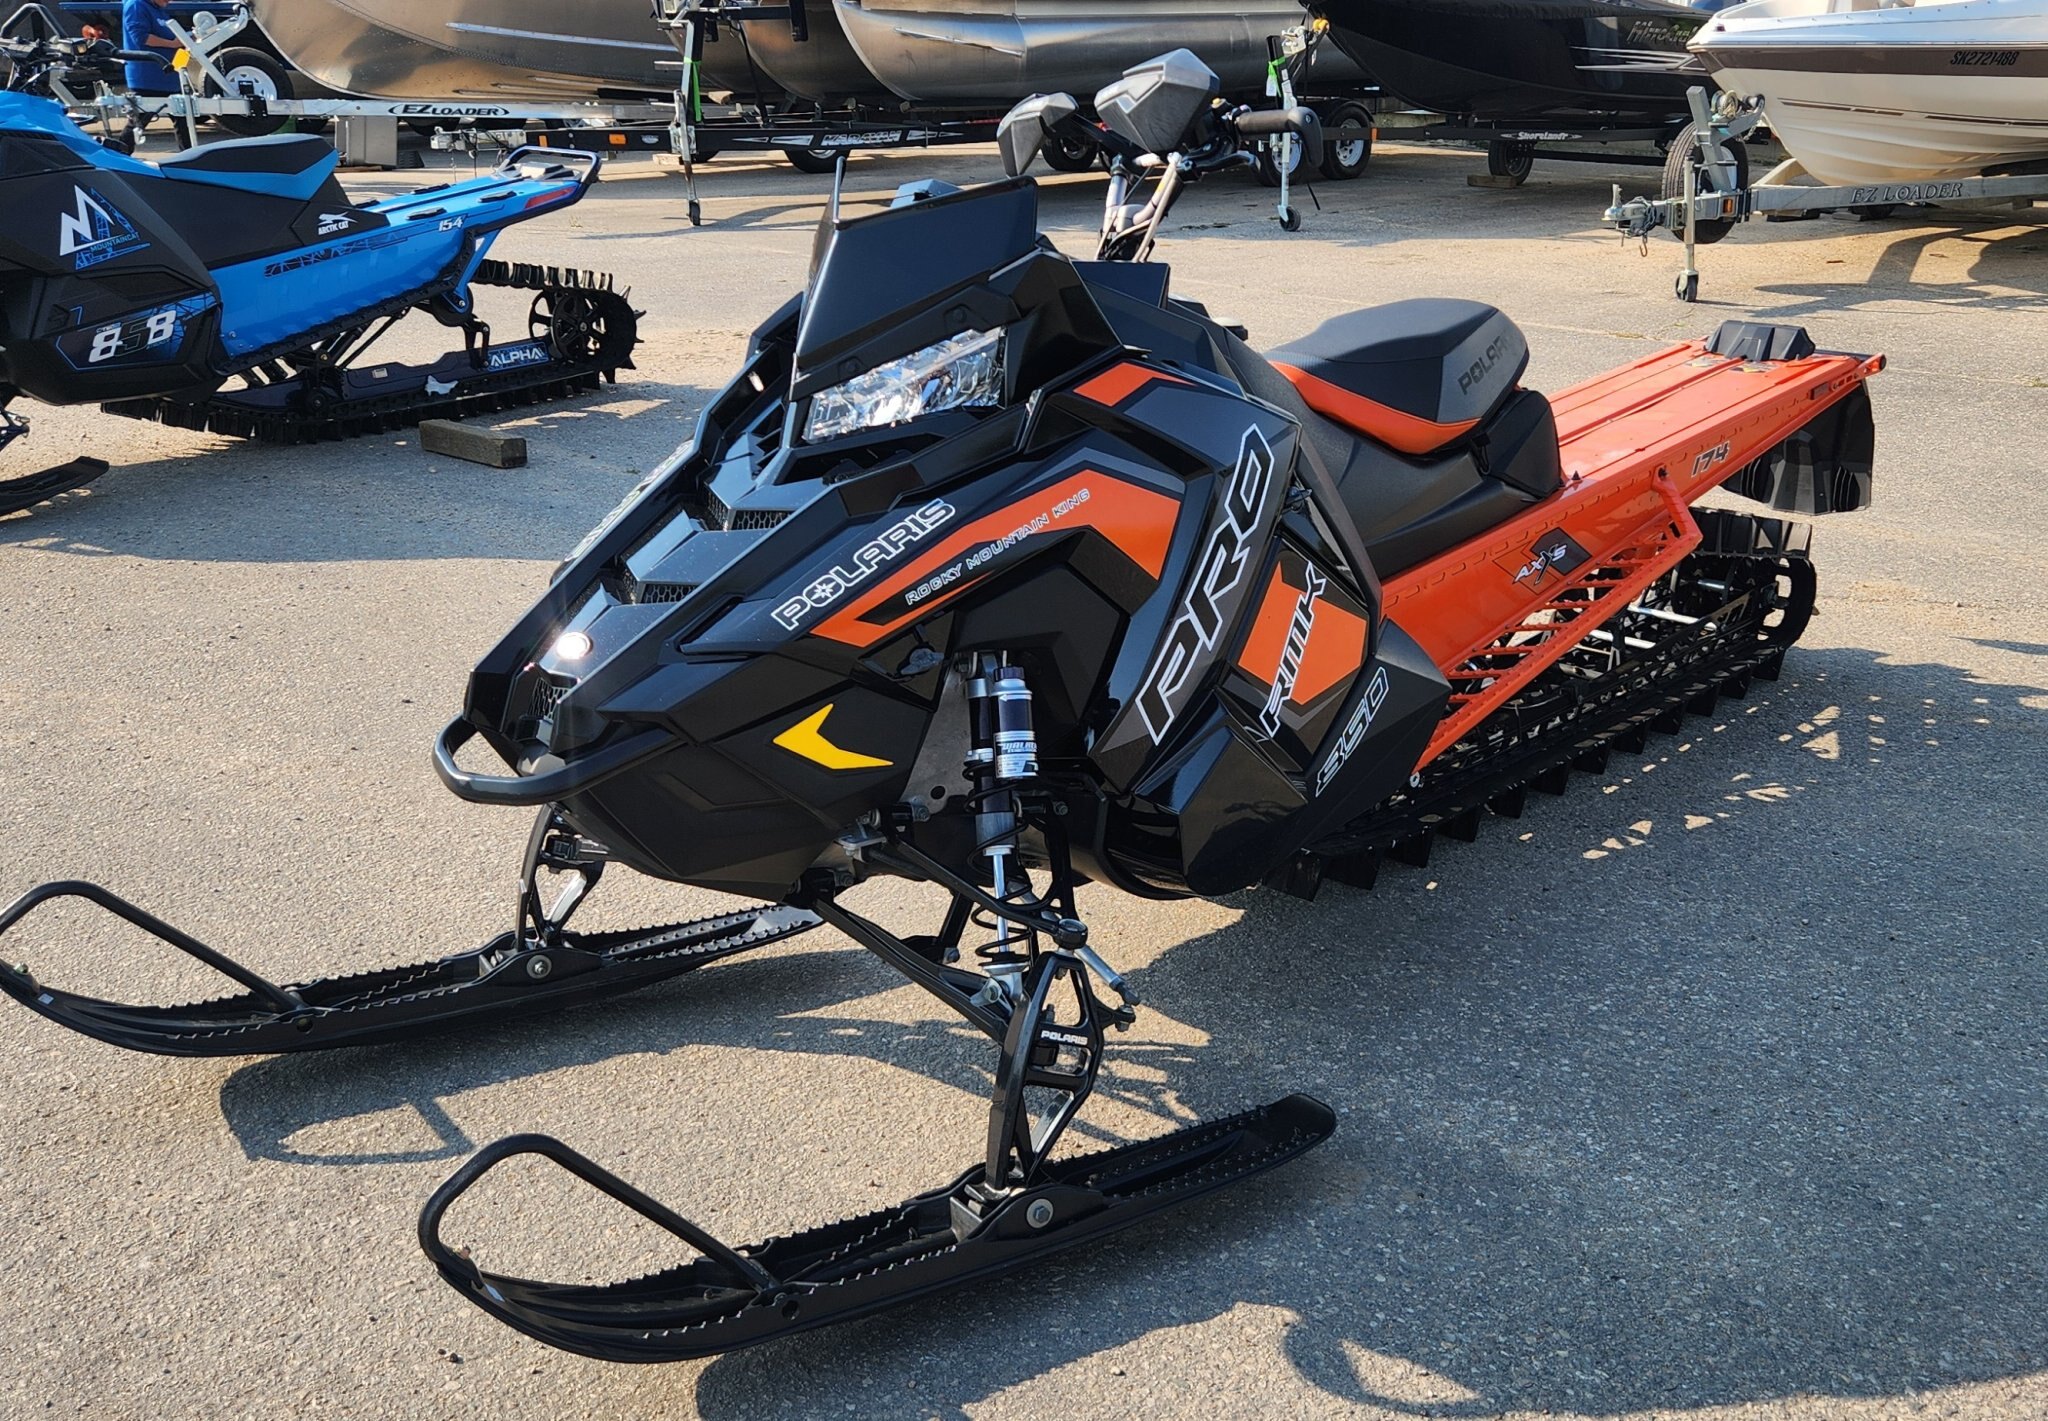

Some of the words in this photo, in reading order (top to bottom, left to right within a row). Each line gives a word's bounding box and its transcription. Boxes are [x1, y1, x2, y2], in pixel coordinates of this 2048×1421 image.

[1950, 50, 2019, 66] SK2721488
[820, 130, 903, 146] KARAVAN
[1850, 187, 1878, 204] EZ
[1882, 182, 1963, 202] LOADER
[318, 223, 338, 236] ARCTIC
[338, 220, 350, 231] CAT
[438, 217, 465, 232] 154
[88, 310, 177, 364] 858
[490, 347, 545, 367] ALPHA
[1690, 440, 1730, 479] 174
[905, 562, 964, 606] ROCKY
[965, 512, 1050, 570] MOUNTAIN
[1052, 488, 1091, 520] KING
[770, 497, 956, 632] POLARIS
[1135, 422, 1275, 747] PRO
[1259, 560, 1328, 738] RMK
[1314, 666, 1390, 798] 850
[1041, 1030, 1089, 1046] POLARIS
